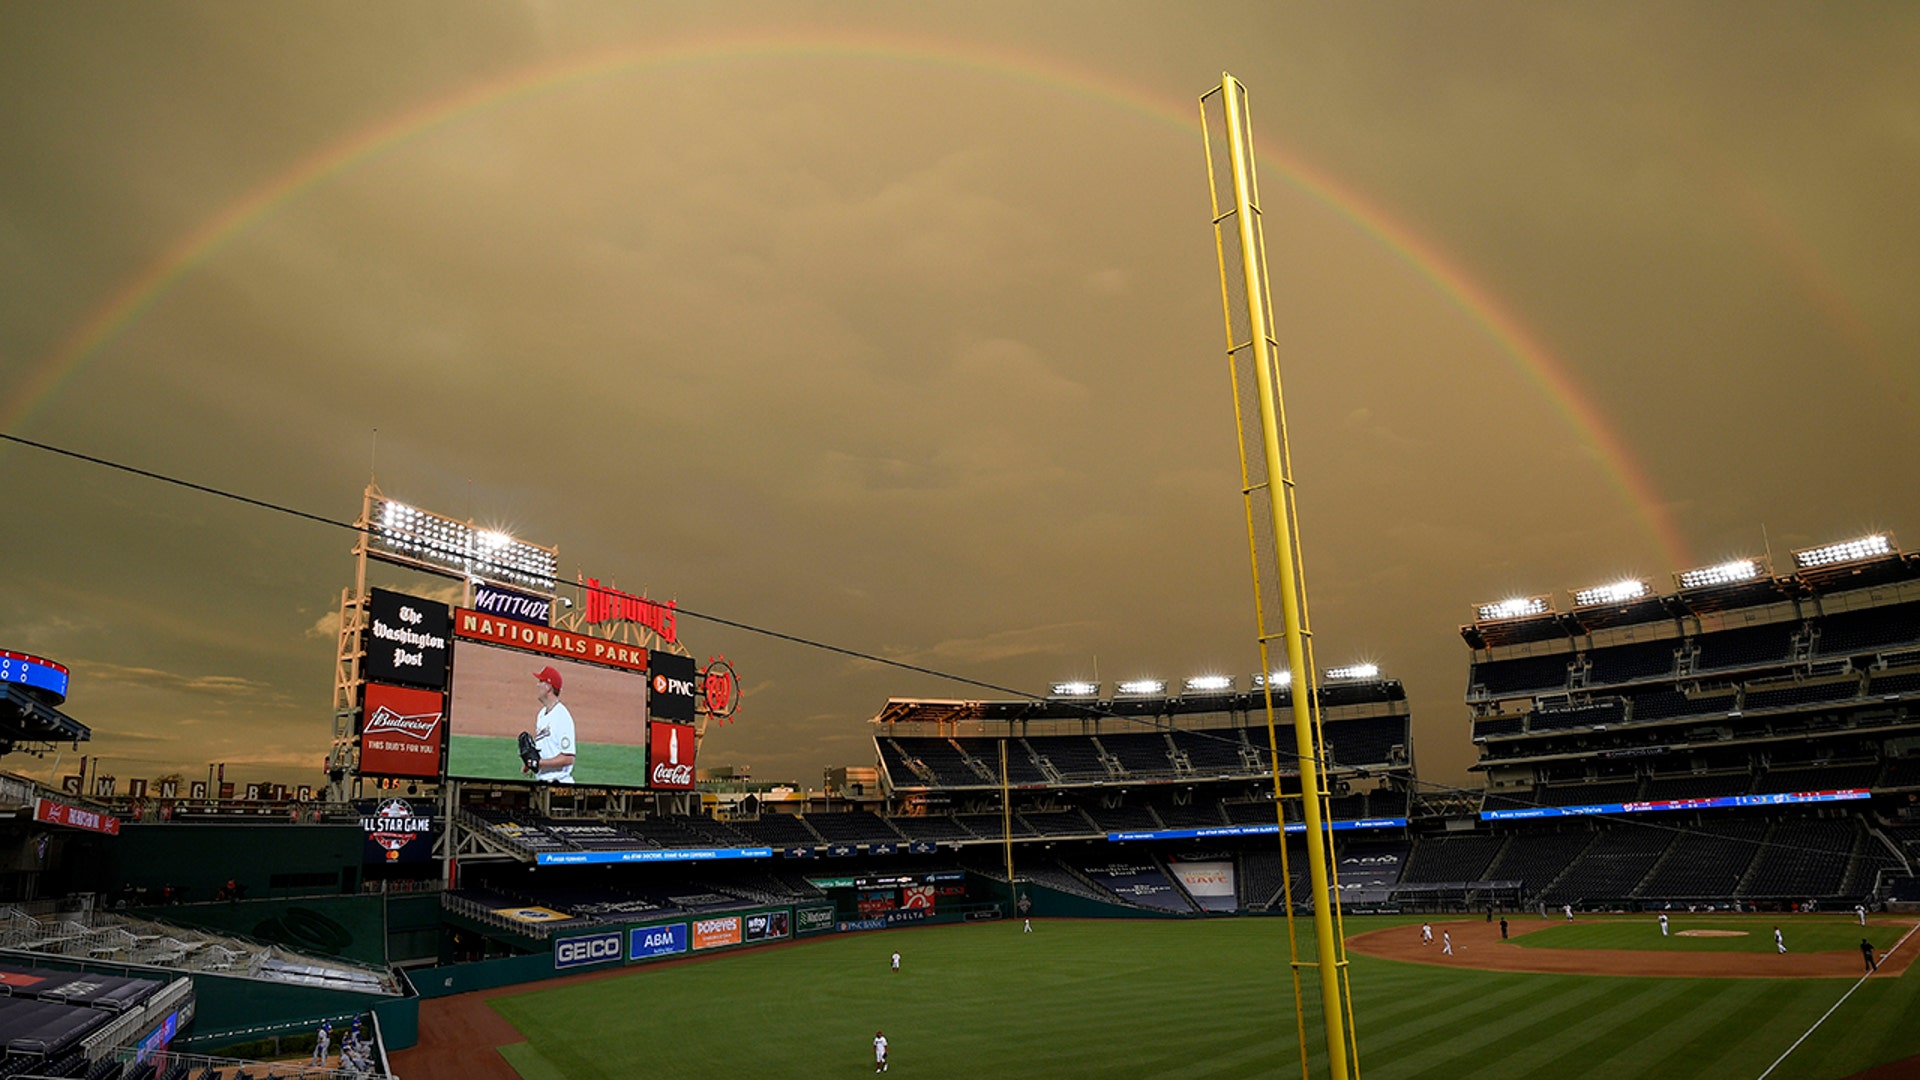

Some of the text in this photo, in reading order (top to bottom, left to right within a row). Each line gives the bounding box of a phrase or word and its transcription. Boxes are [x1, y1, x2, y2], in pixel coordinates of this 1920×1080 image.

[475, 589, 549, 620] NATITUDE
[586, 578, 676, 643] NATIONALS
[399, 606, 423, 624] The
[373, 619, 445, 649] Washington
[464, 615, 640, 665] NATIONALS PARK
[393, 648, 423, 667] Post
[668, 678, 694, 697] PNC
[374, 712, 433, 730] Budweiser
[368, 741, 384, 750] THIS
[406, 743, 419, 752] FOR
[377, 818, 402, 831] STAR
[404, 818, 429, 831] GAME
[896, 912, 924, 920] DELTA
[697, 918, 737, 935] POPEYES
[644, 931, 674, 948] ABM
[559, 938, 619, 962] GEICO
